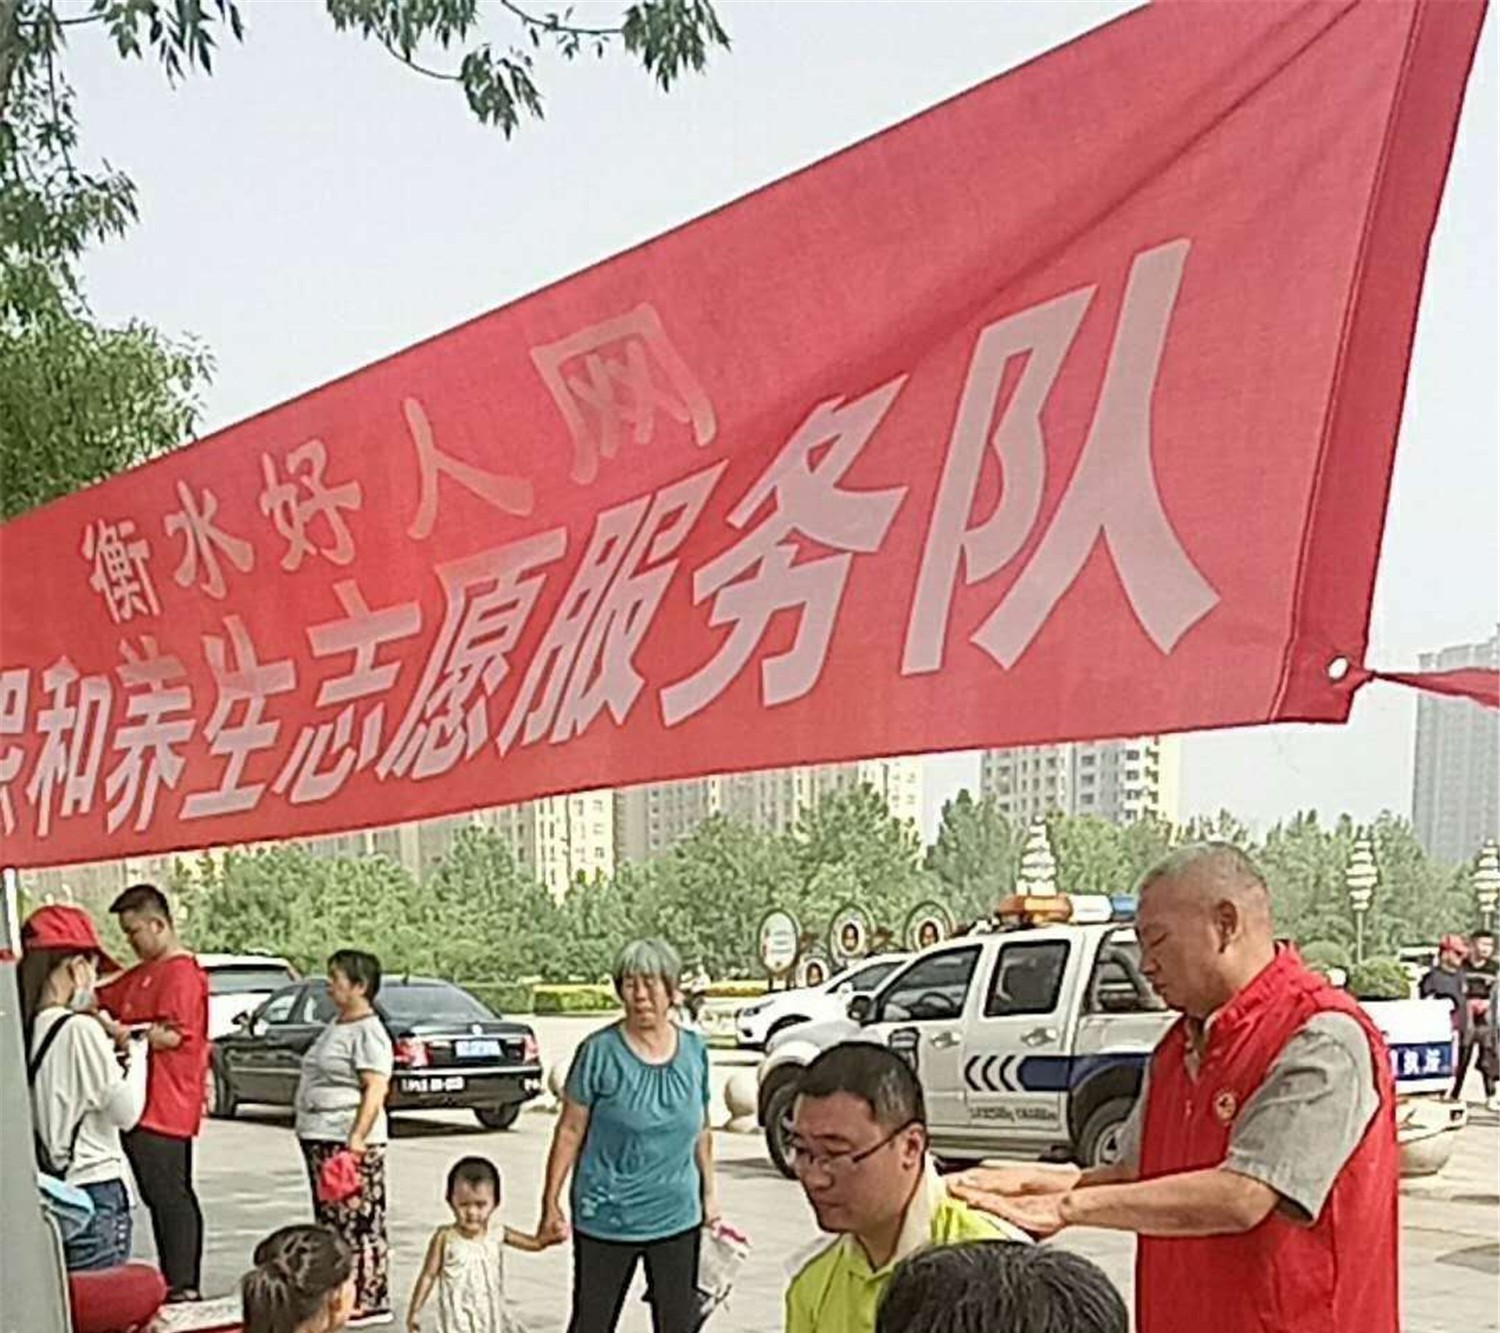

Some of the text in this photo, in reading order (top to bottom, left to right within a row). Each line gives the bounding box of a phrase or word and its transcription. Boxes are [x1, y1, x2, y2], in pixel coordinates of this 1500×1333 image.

[81, 303, 716, 623] 衡水好人网
